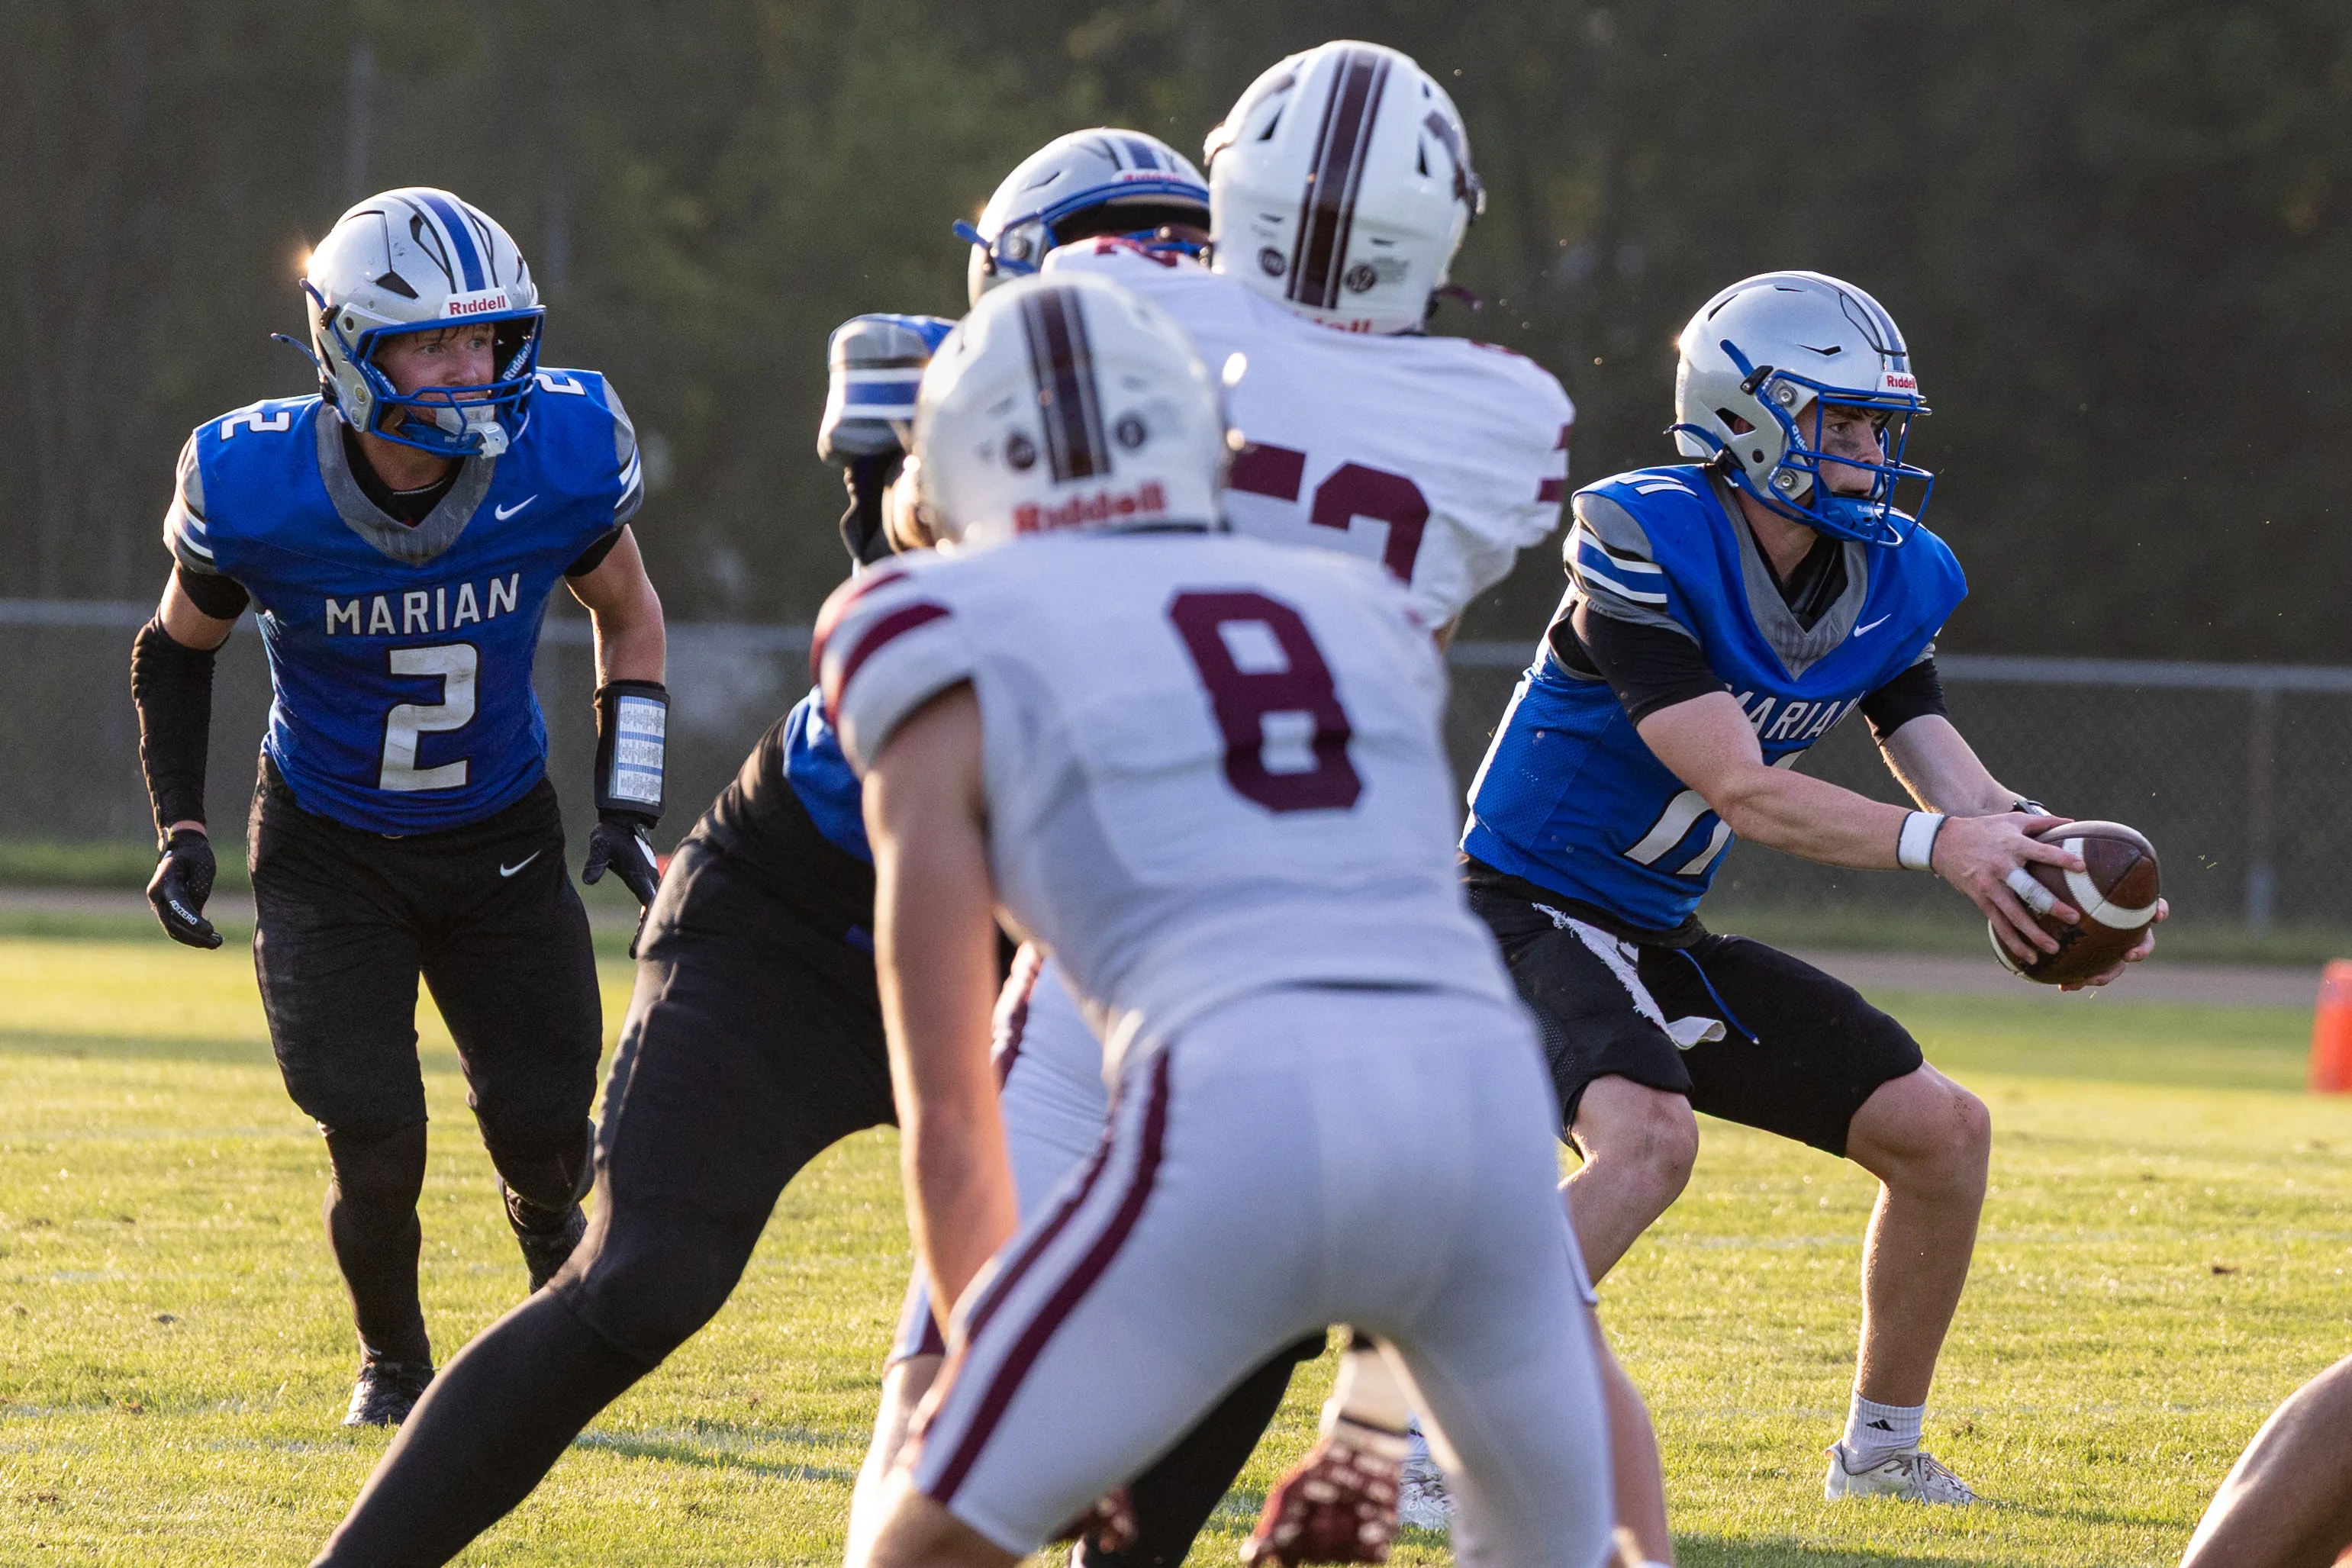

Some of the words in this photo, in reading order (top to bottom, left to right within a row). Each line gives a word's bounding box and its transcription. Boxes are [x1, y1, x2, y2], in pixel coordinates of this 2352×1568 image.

[449, 295, 506, 315] Riddell
[221, 411, 291, 442] 2
[324, 572, 520, 636] MARIAN
[379, 642, 481, 791] 2
[1166, 591, 1363, 813] 8
[169, 900, 198, 926] ADIZERO
